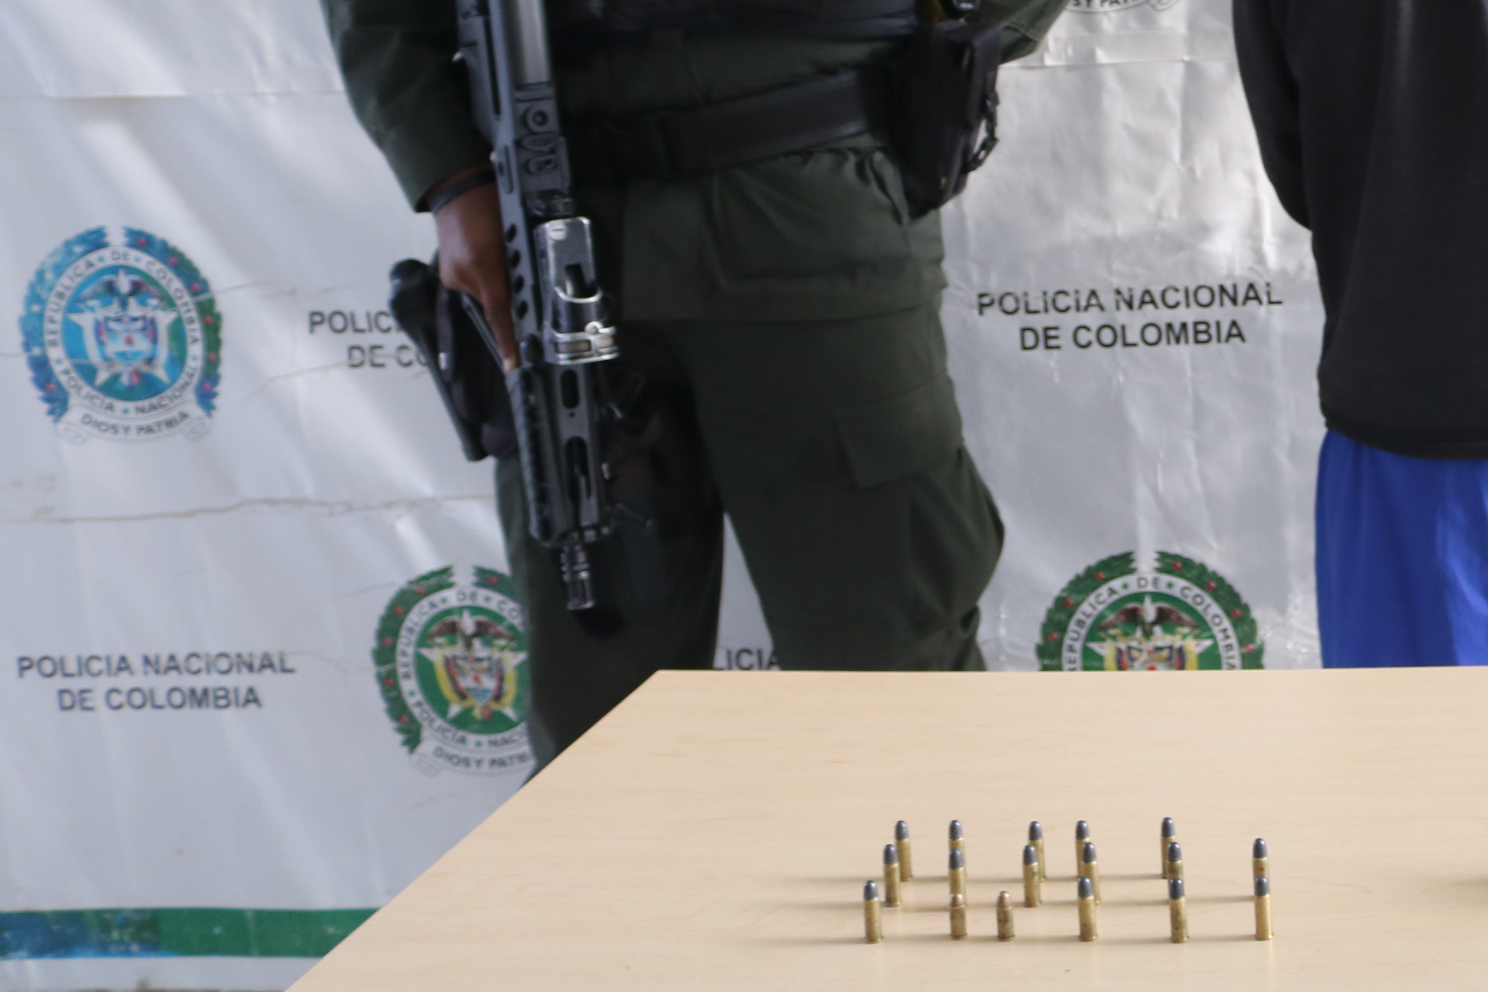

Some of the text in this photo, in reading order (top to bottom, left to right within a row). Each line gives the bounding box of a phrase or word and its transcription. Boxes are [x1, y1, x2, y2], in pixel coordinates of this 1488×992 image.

[976, 281, 1284, 317] POLICIA NACIONAL
[309, 309, 393, 335] POLIC
[1019, 318, 1247, 352] DE COLOMBIA
[347, 344, 386, 369] DE
[1136, 577, 1160, 588] DE
[17, 651, 296, 679] POLICIA NACIONAL
[57, 686, 262, 712] DE COLOMBIA
